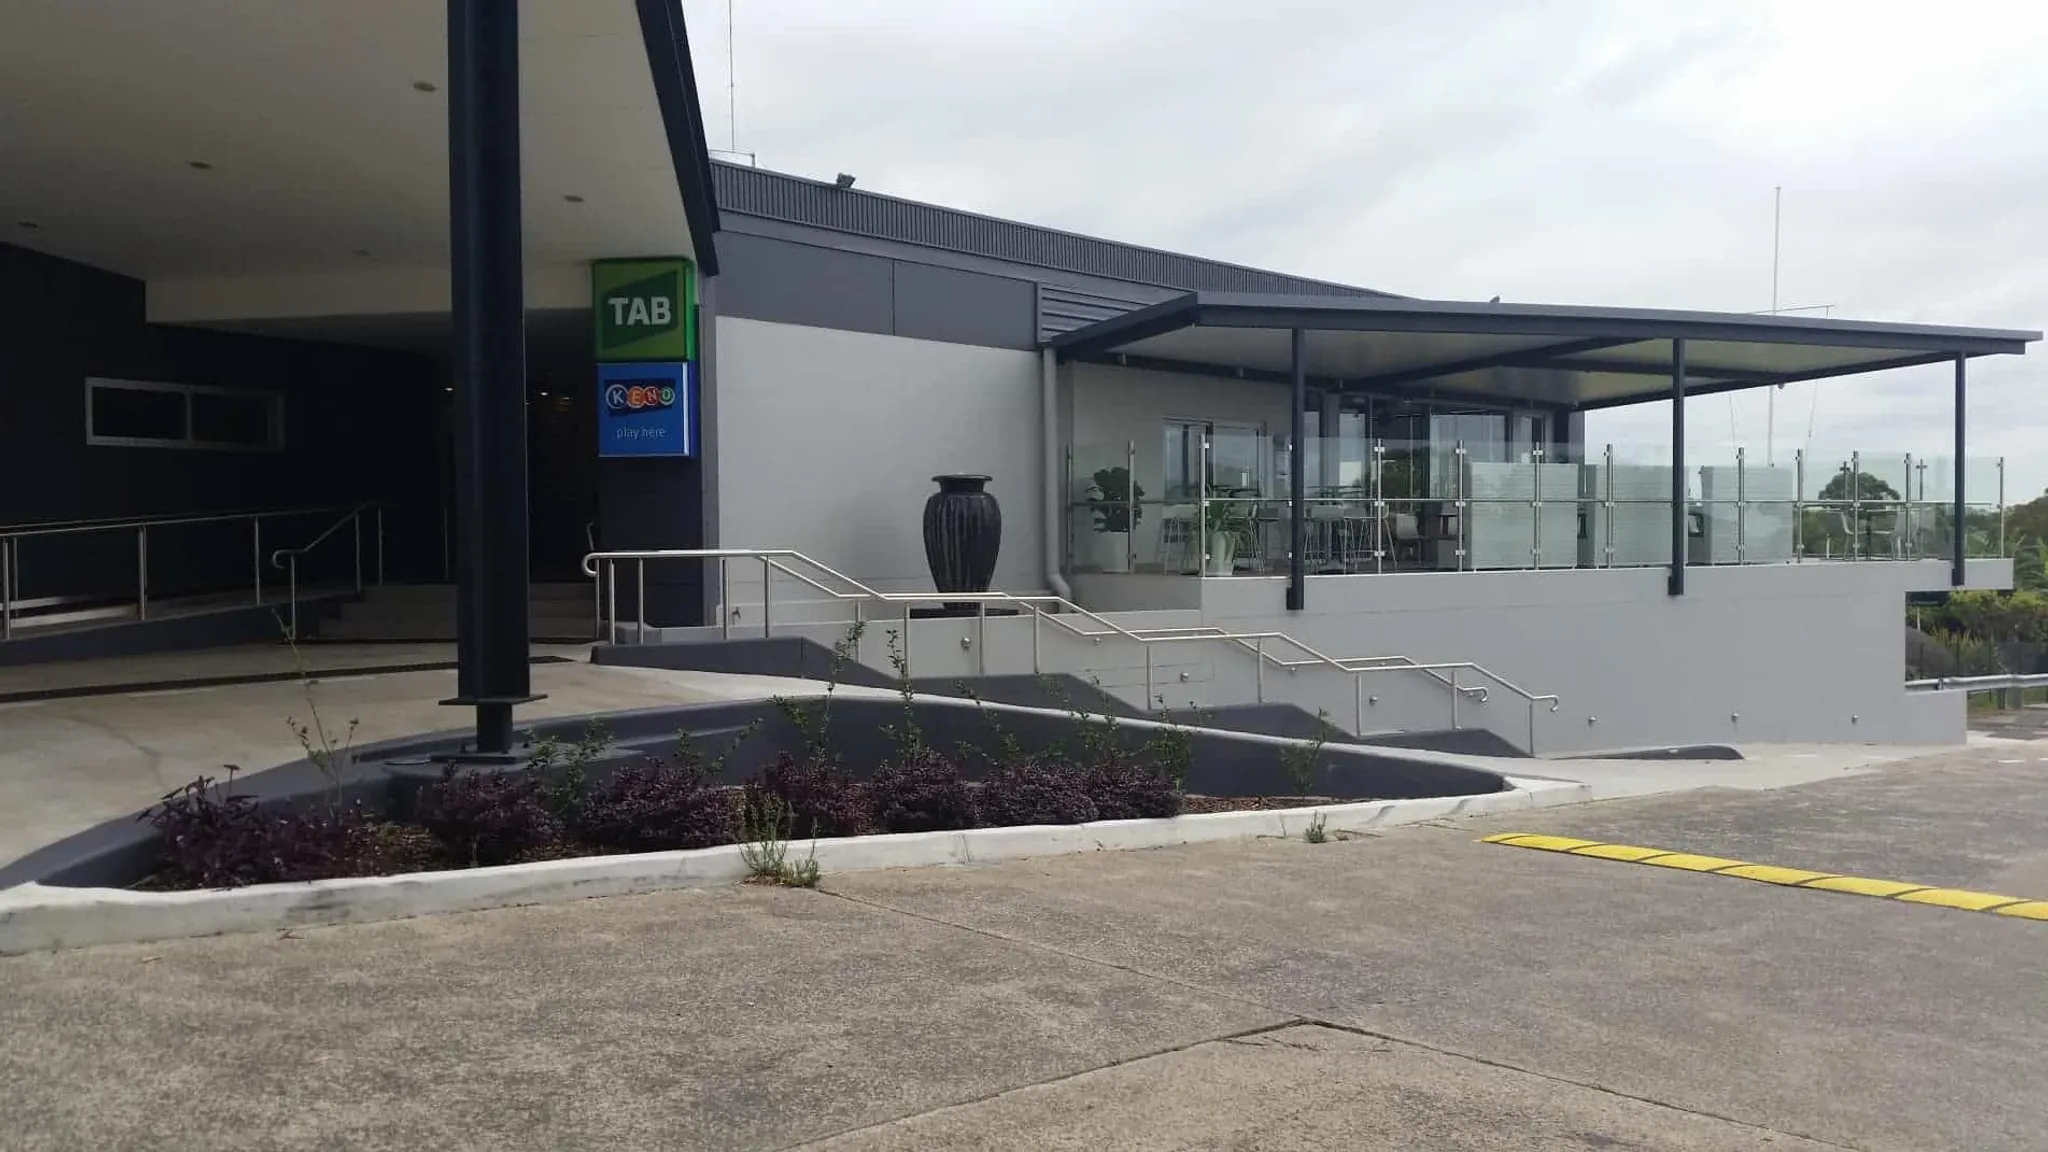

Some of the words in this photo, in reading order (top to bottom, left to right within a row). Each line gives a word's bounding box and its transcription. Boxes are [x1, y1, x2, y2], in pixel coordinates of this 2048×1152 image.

[608, 297, 671, 325] TAB
[608, 386, 674, 407] KENO
[616, 426, 639, 439] play
[641, 426, 666, 437] here
